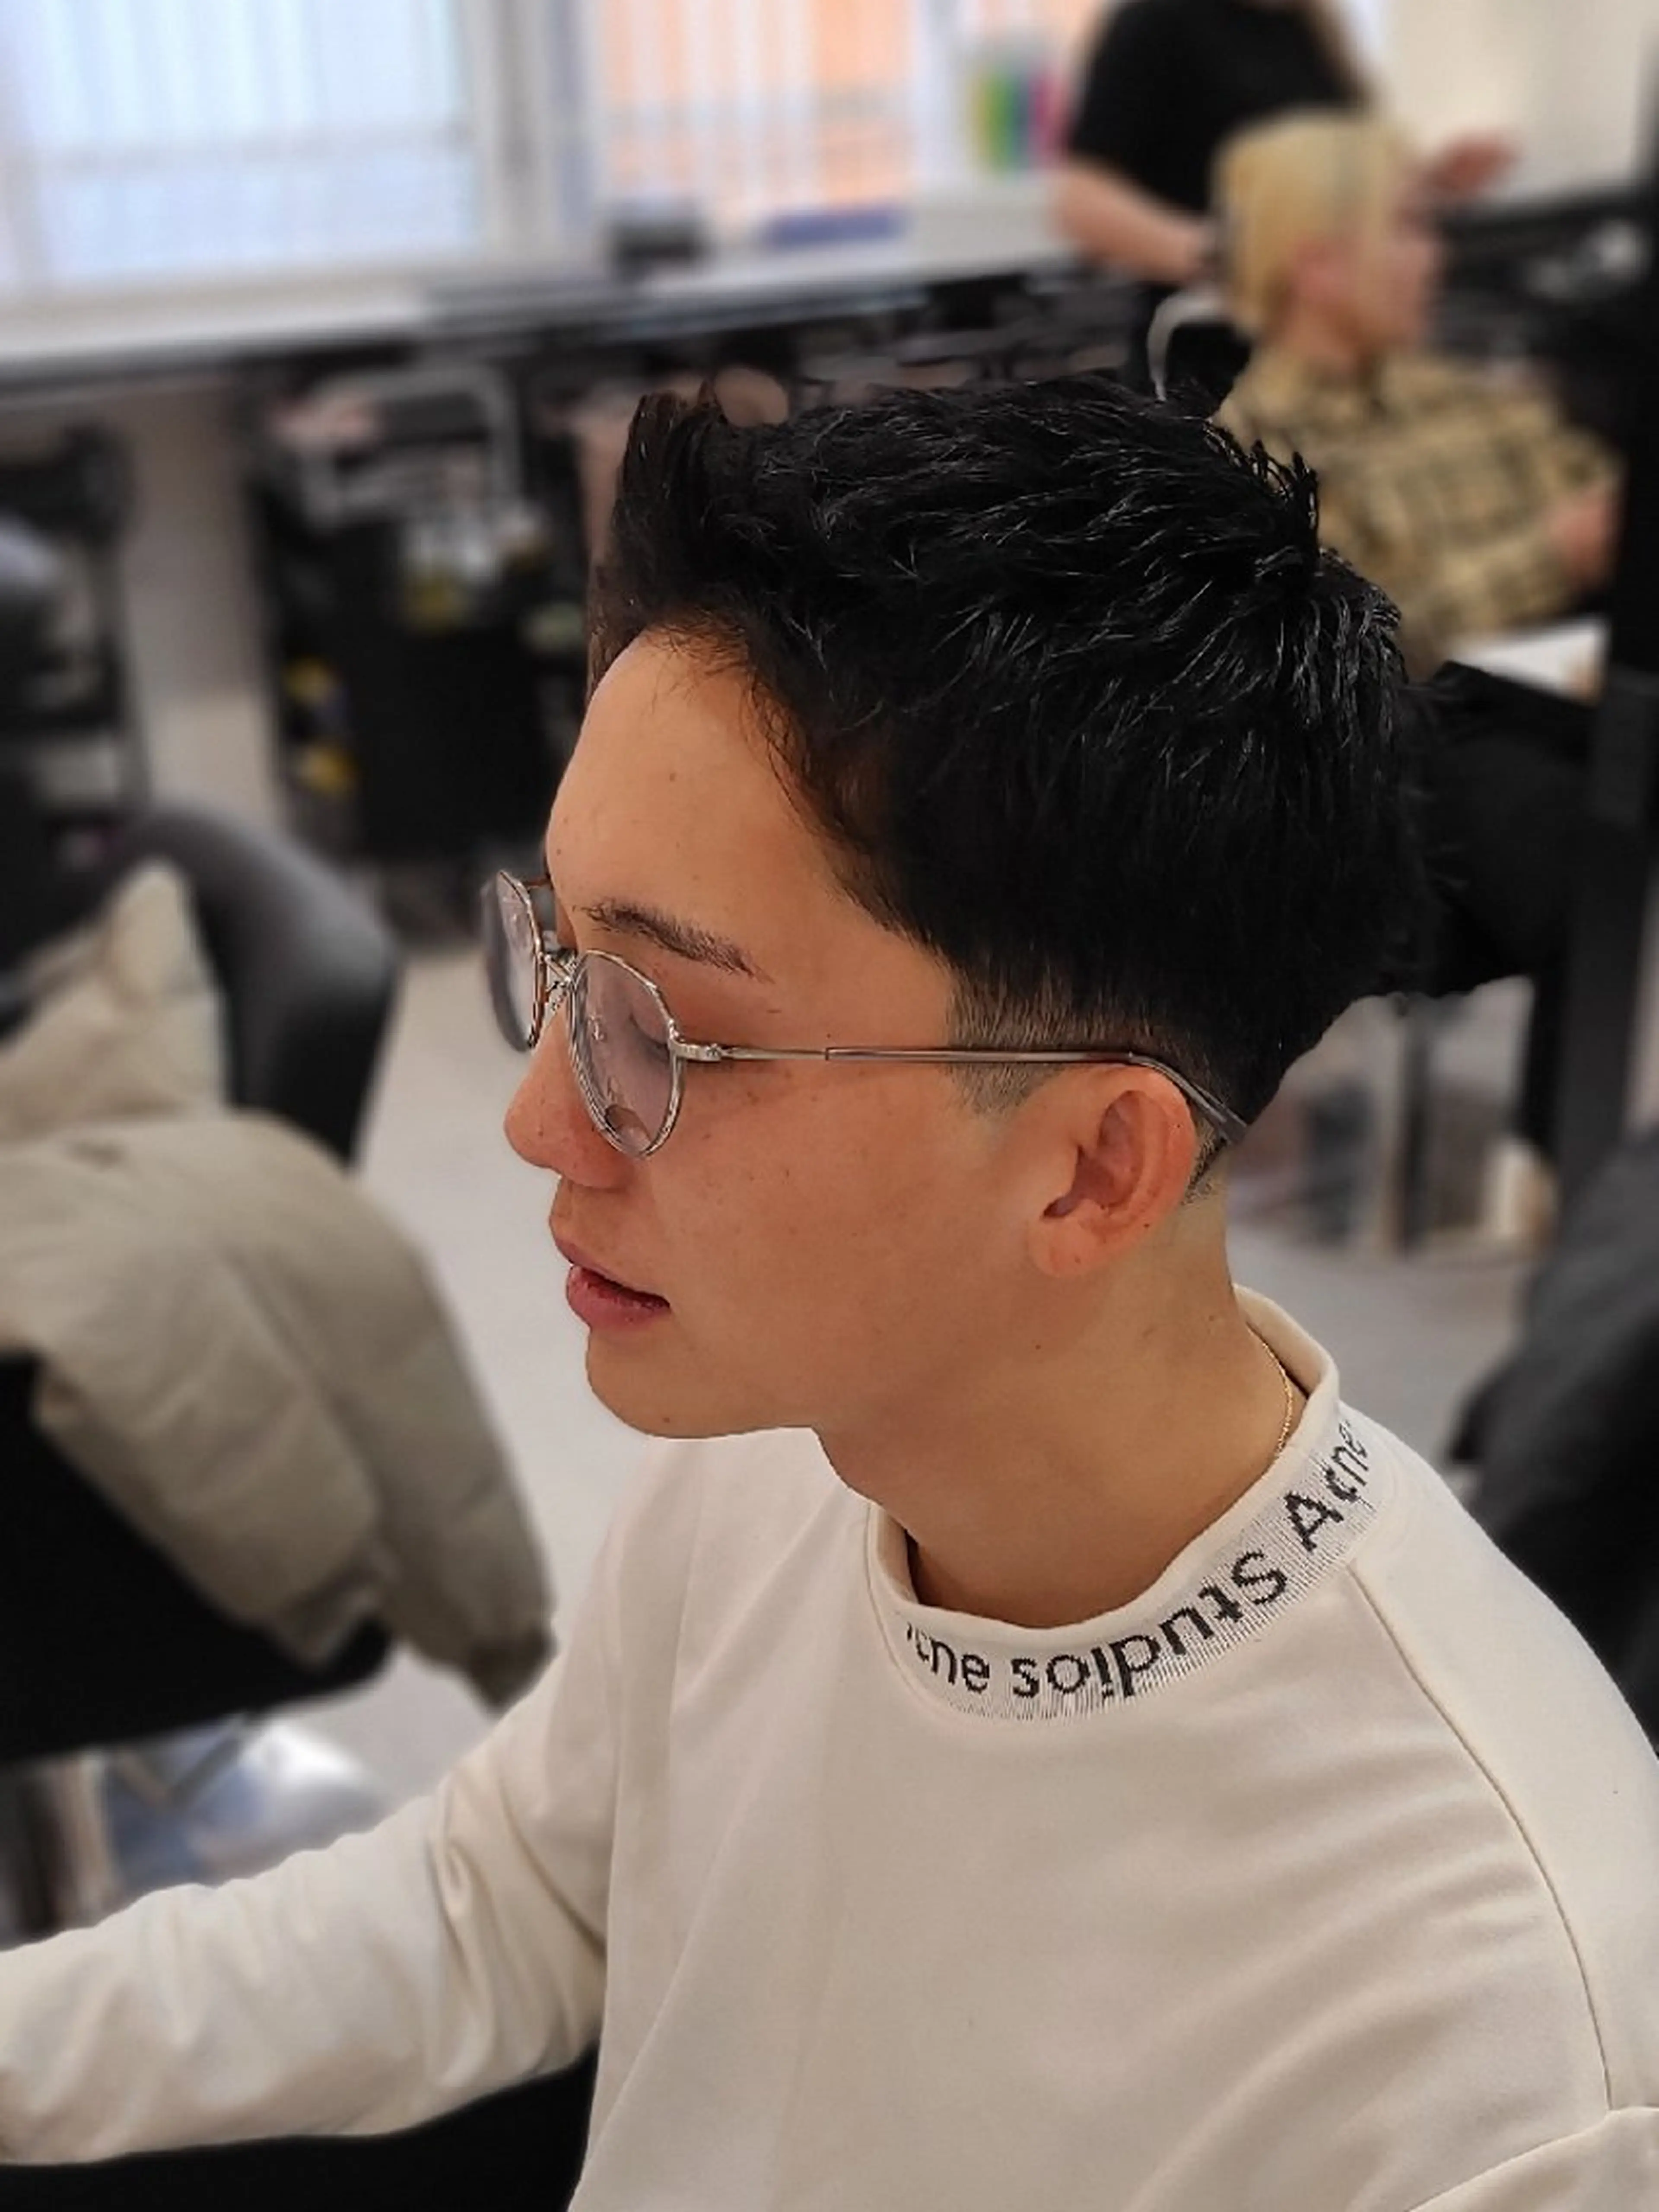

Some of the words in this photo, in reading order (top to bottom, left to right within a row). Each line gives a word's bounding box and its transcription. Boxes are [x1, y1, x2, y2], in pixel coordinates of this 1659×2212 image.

[906, 1622, 990, 1694] cne
[1012, 1548, 1287, 1698] Studios
[1284, 1420, 1369, 1551] Acne
